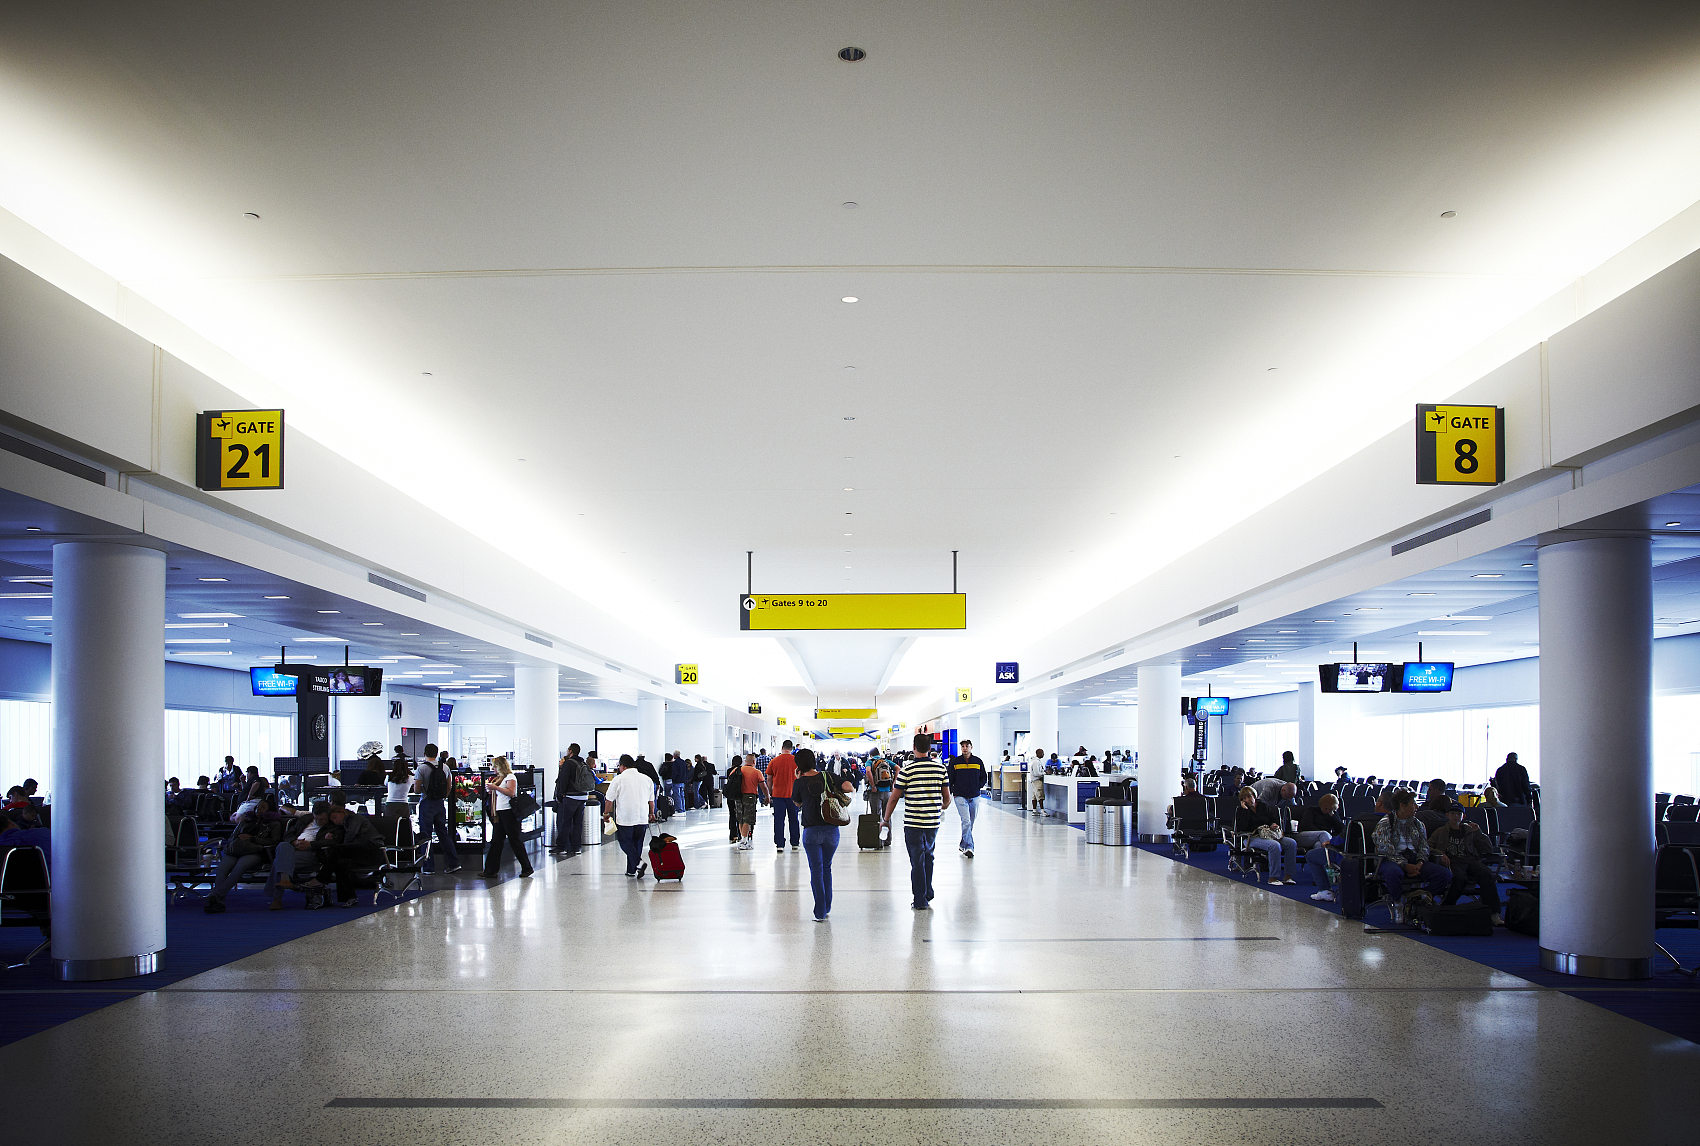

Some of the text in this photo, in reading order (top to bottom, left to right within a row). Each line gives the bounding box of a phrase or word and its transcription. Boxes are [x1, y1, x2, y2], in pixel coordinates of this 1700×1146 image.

[236, 421, 275, 434] GATE
[1450, 416, 1489, 429] GATE
[226, 443, 270, 479] 21
[1454, 438, 1479, 474] 8
[771, 599, 828, 607] Gates 9 to 20
[682, 672, 697, 682] 20
[998, 672, 1015, 680] ASK
[1408, 675, 1428, 683] FREE
[257, 680, 276, 688] FREE
[962, 693, 968, 701] 9
[390, 700, 403, 719] 20
